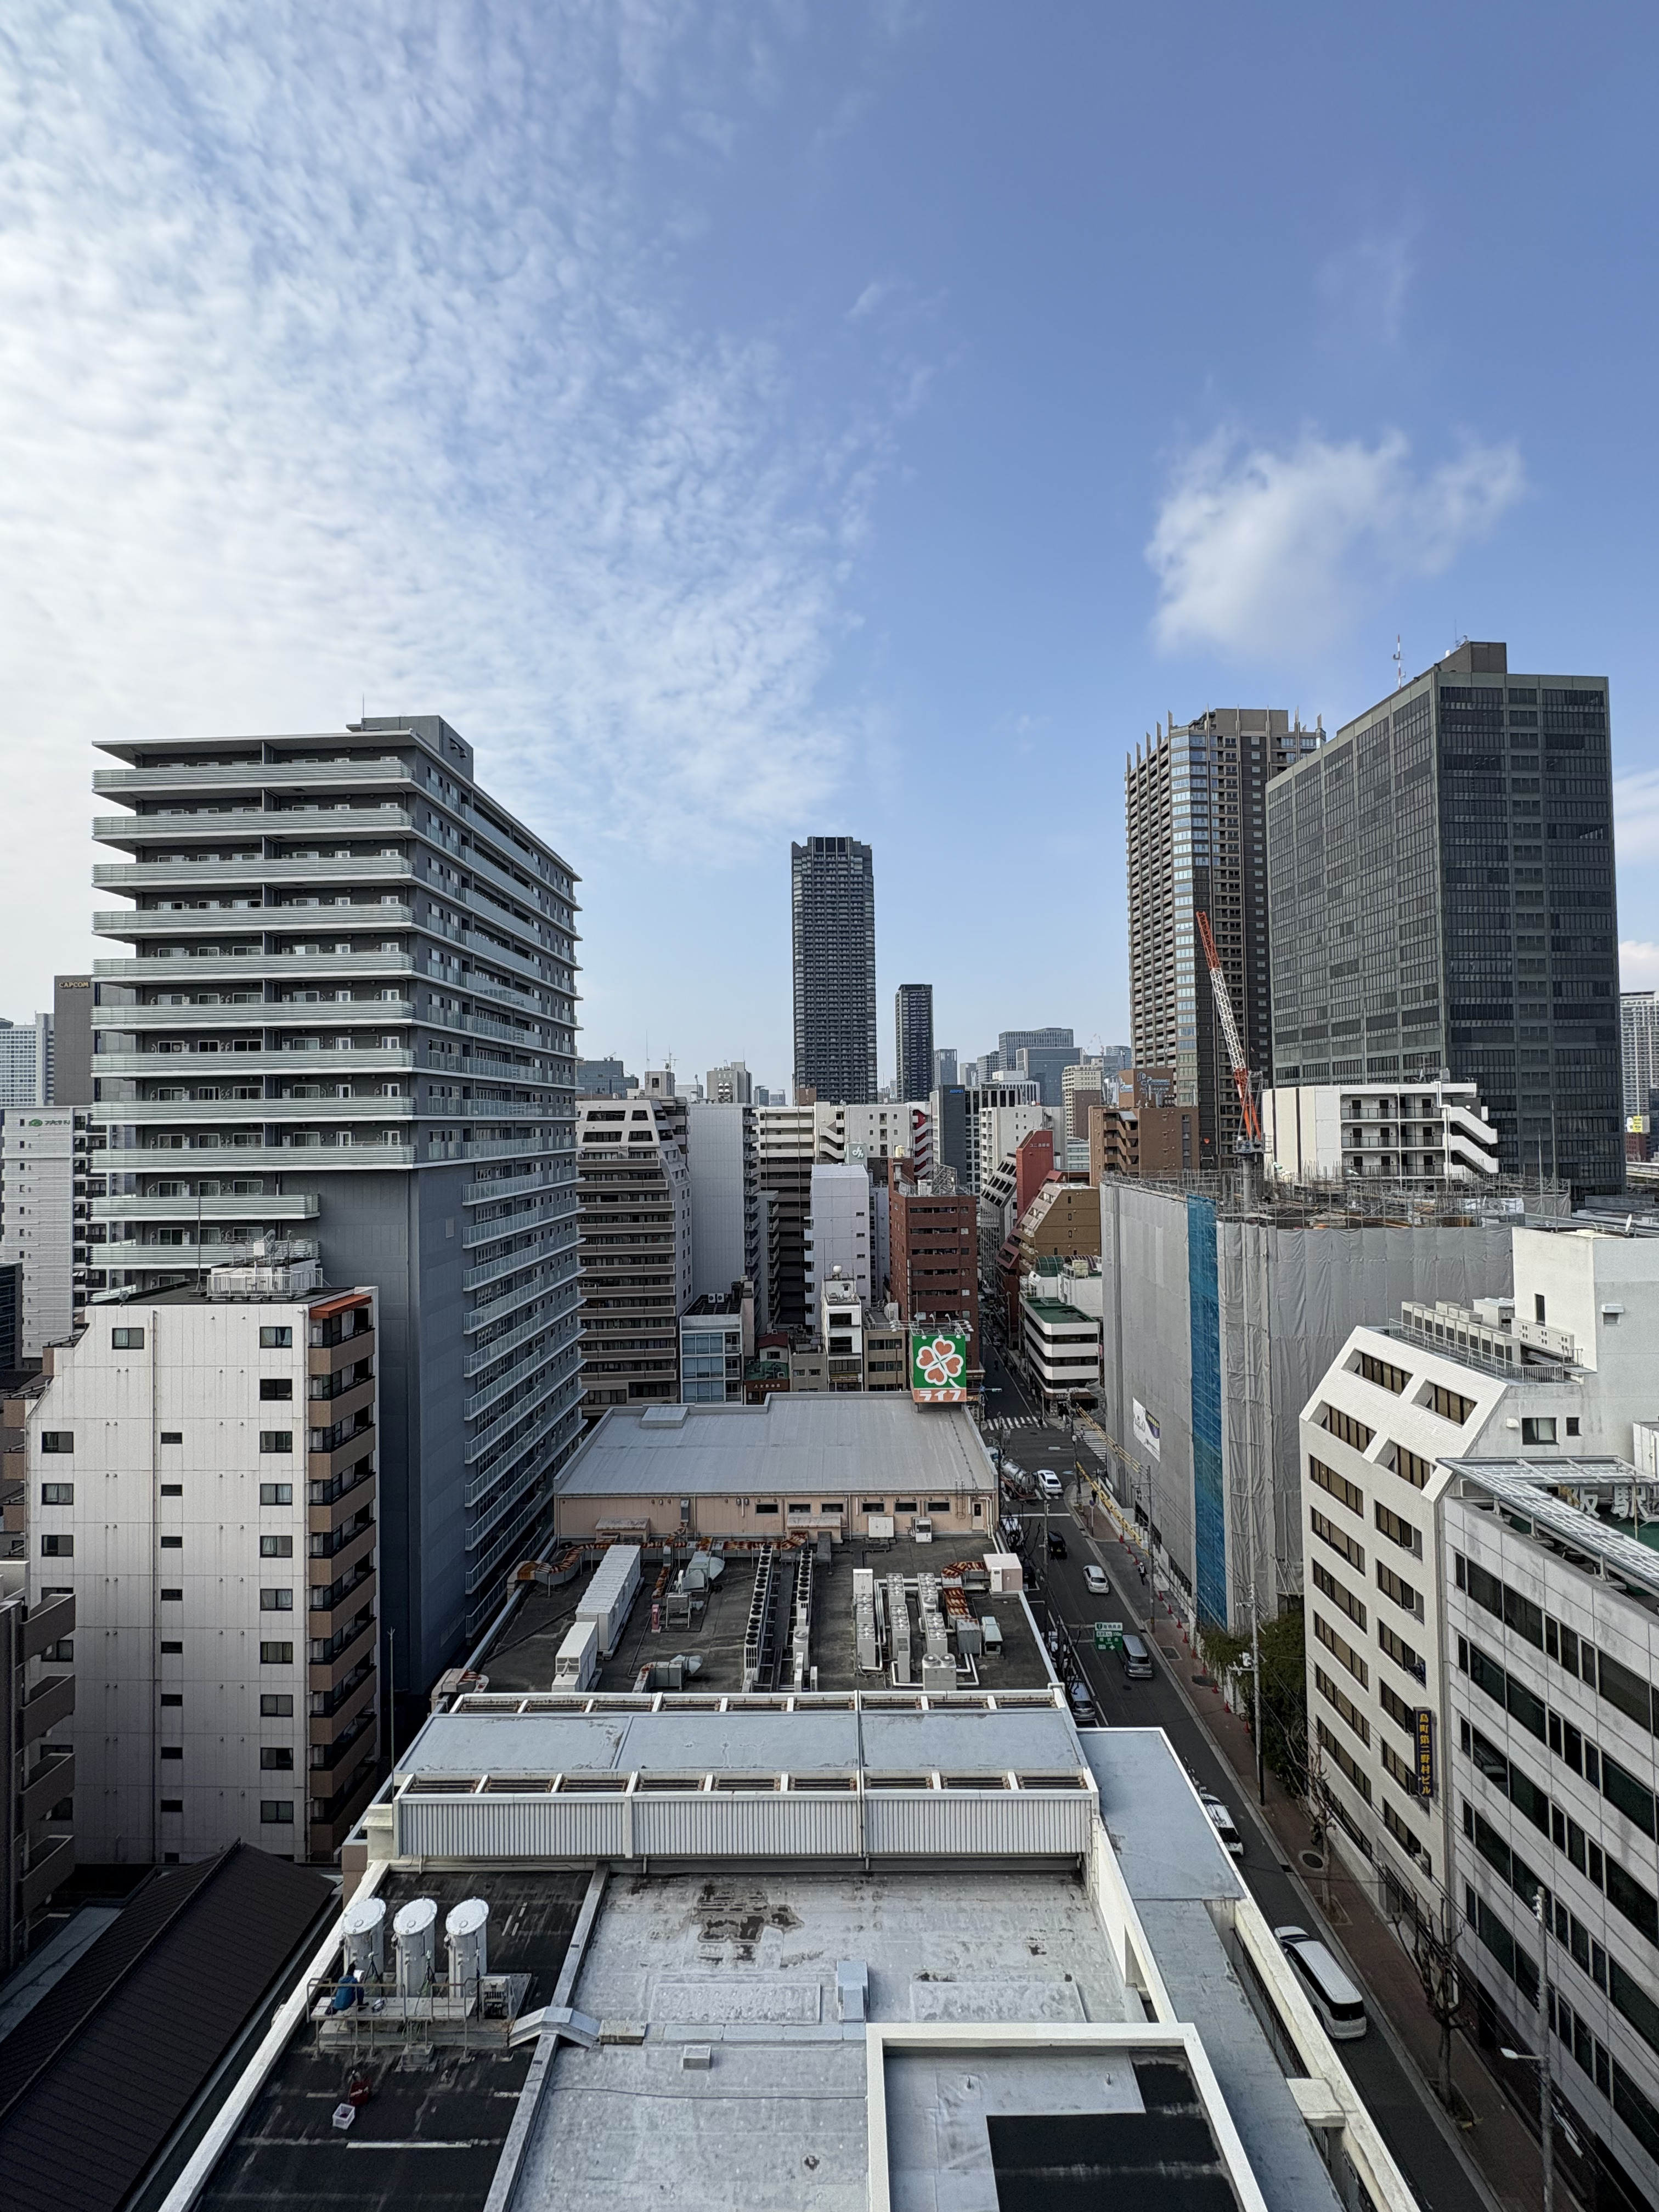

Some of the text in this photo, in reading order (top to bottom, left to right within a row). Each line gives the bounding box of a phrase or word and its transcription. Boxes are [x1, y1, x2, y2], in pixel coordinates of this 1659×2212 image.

[919, 1390, 961, 1401] ライフ
[1419, 1713, 1431, 1795] 島町第二野村ビル
